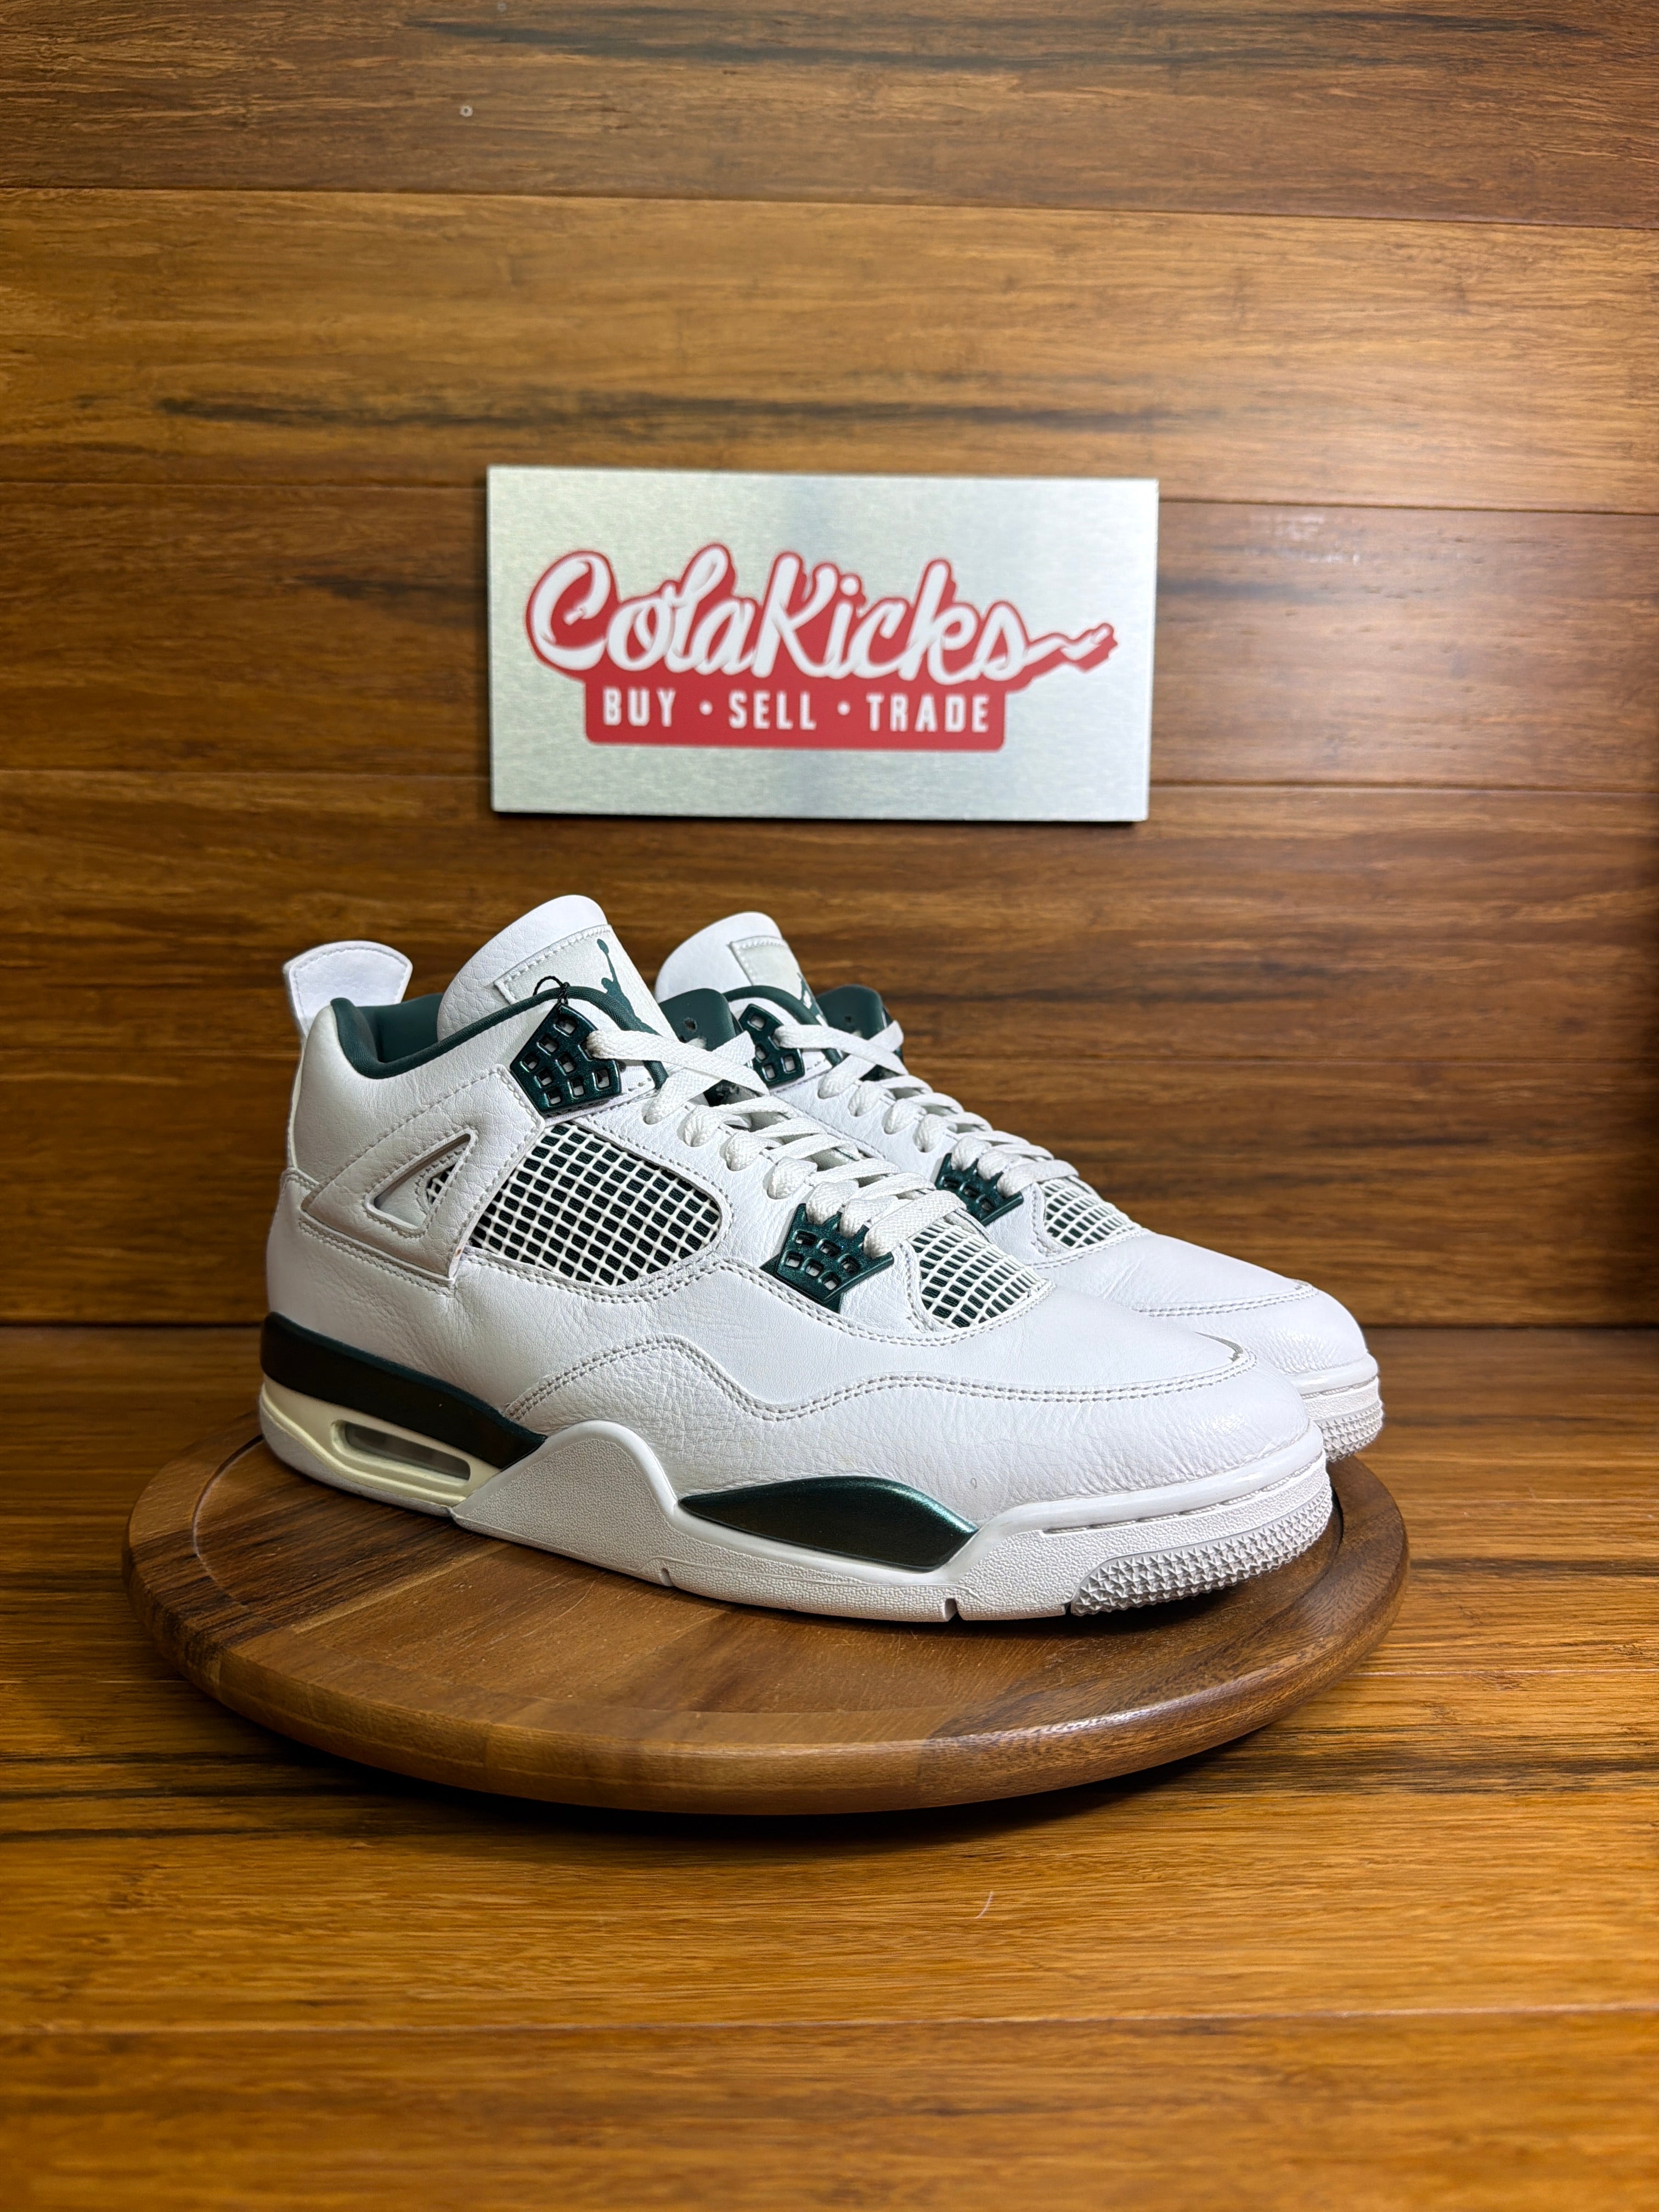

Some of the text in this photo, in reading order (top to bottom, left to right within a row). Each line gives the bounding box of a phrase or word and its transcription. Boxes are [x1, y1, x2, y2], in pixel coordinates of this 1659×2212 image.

[528, 545, 1113, 684] ColaKicks
[603, 687, 990, 733] BUY SELL TRADE
